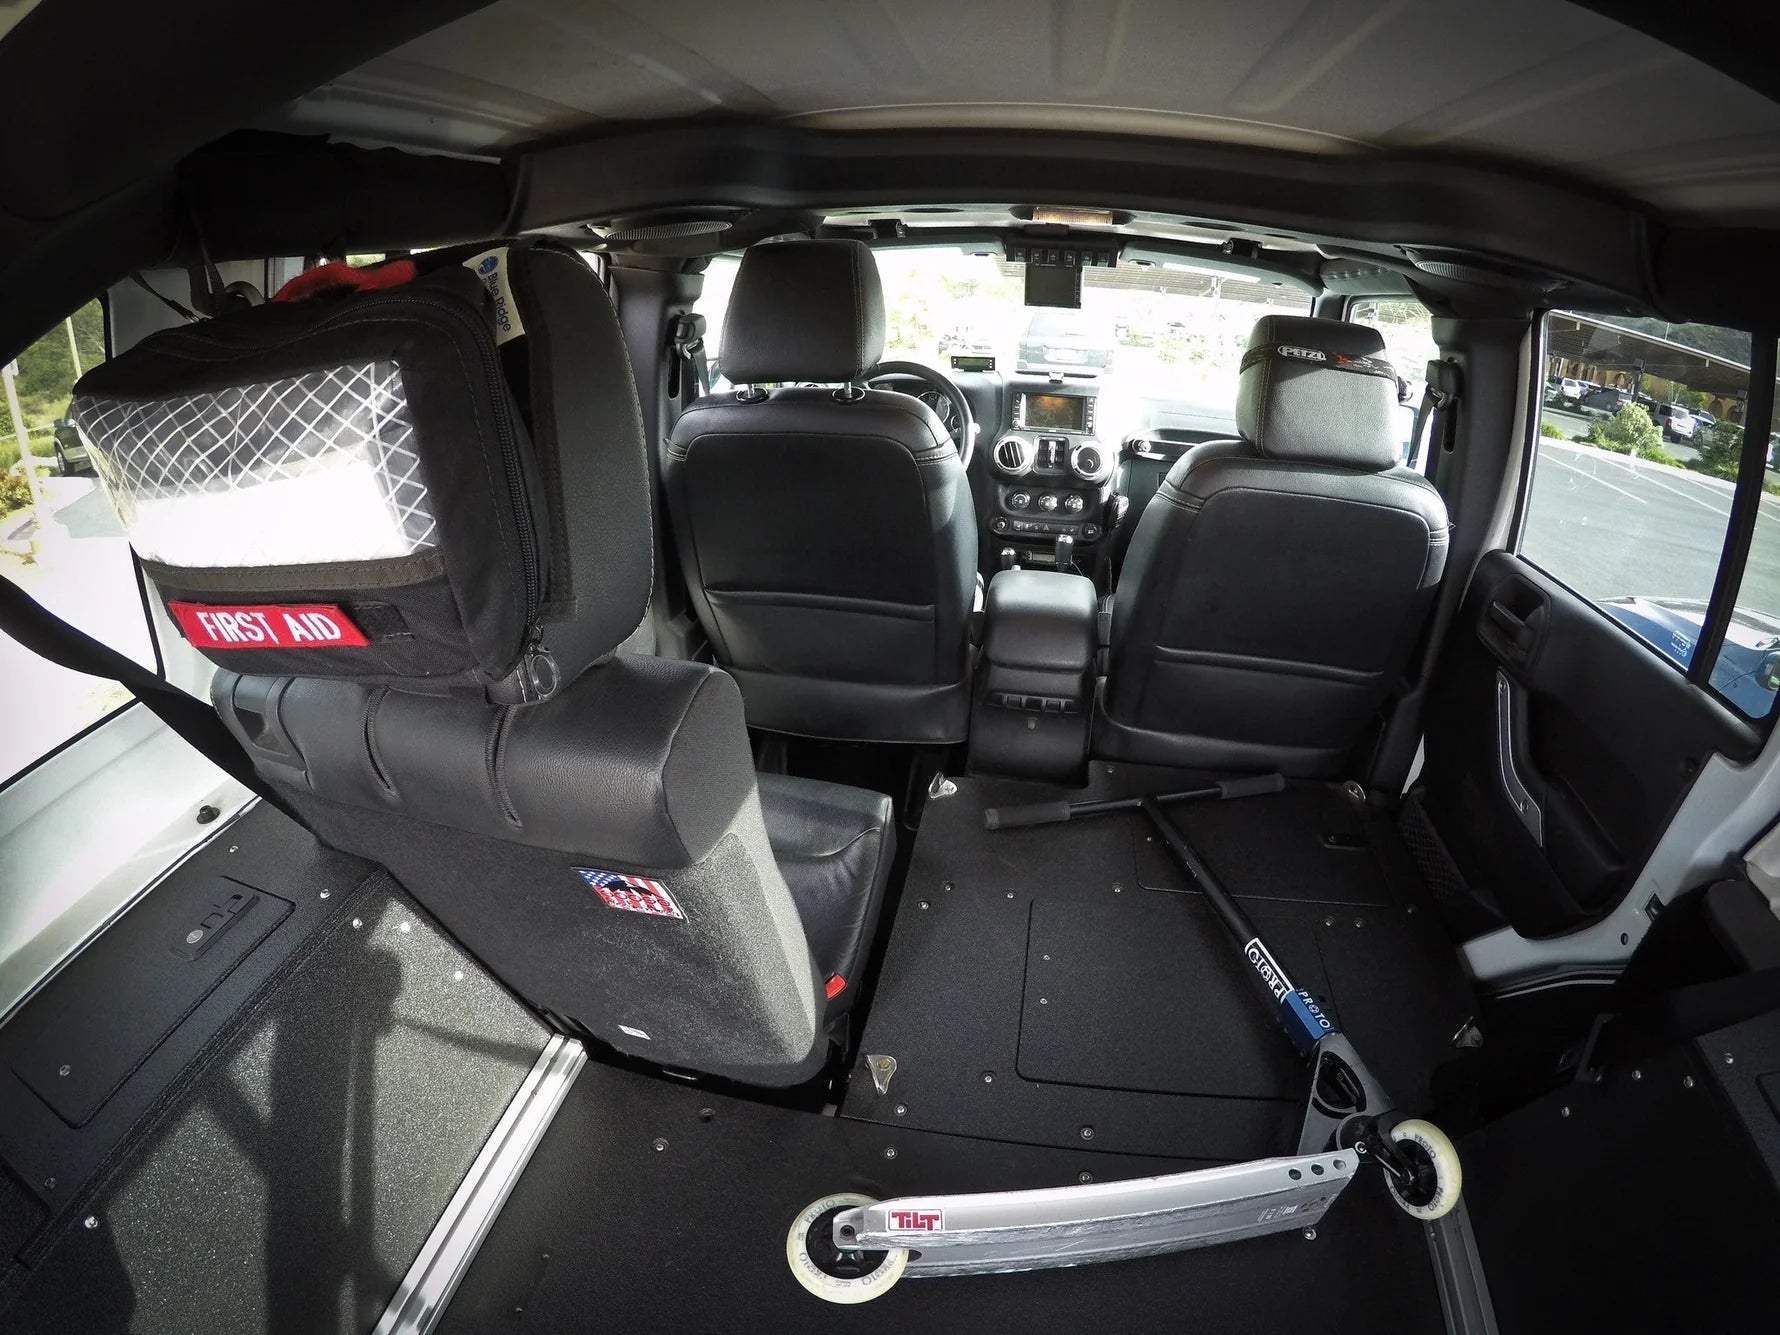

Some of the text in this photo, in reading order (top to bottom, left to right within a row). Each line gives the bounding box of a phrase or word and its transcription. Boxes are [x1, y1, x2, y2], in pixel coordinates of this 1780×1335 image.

[488, 272, 511, 332] Blue Ridge
[196, 611, 341, 644] FIRST AID
[1247, 947, 1287, 1001] PROTO
[1297, 991, 1331, 1028] PROTO
